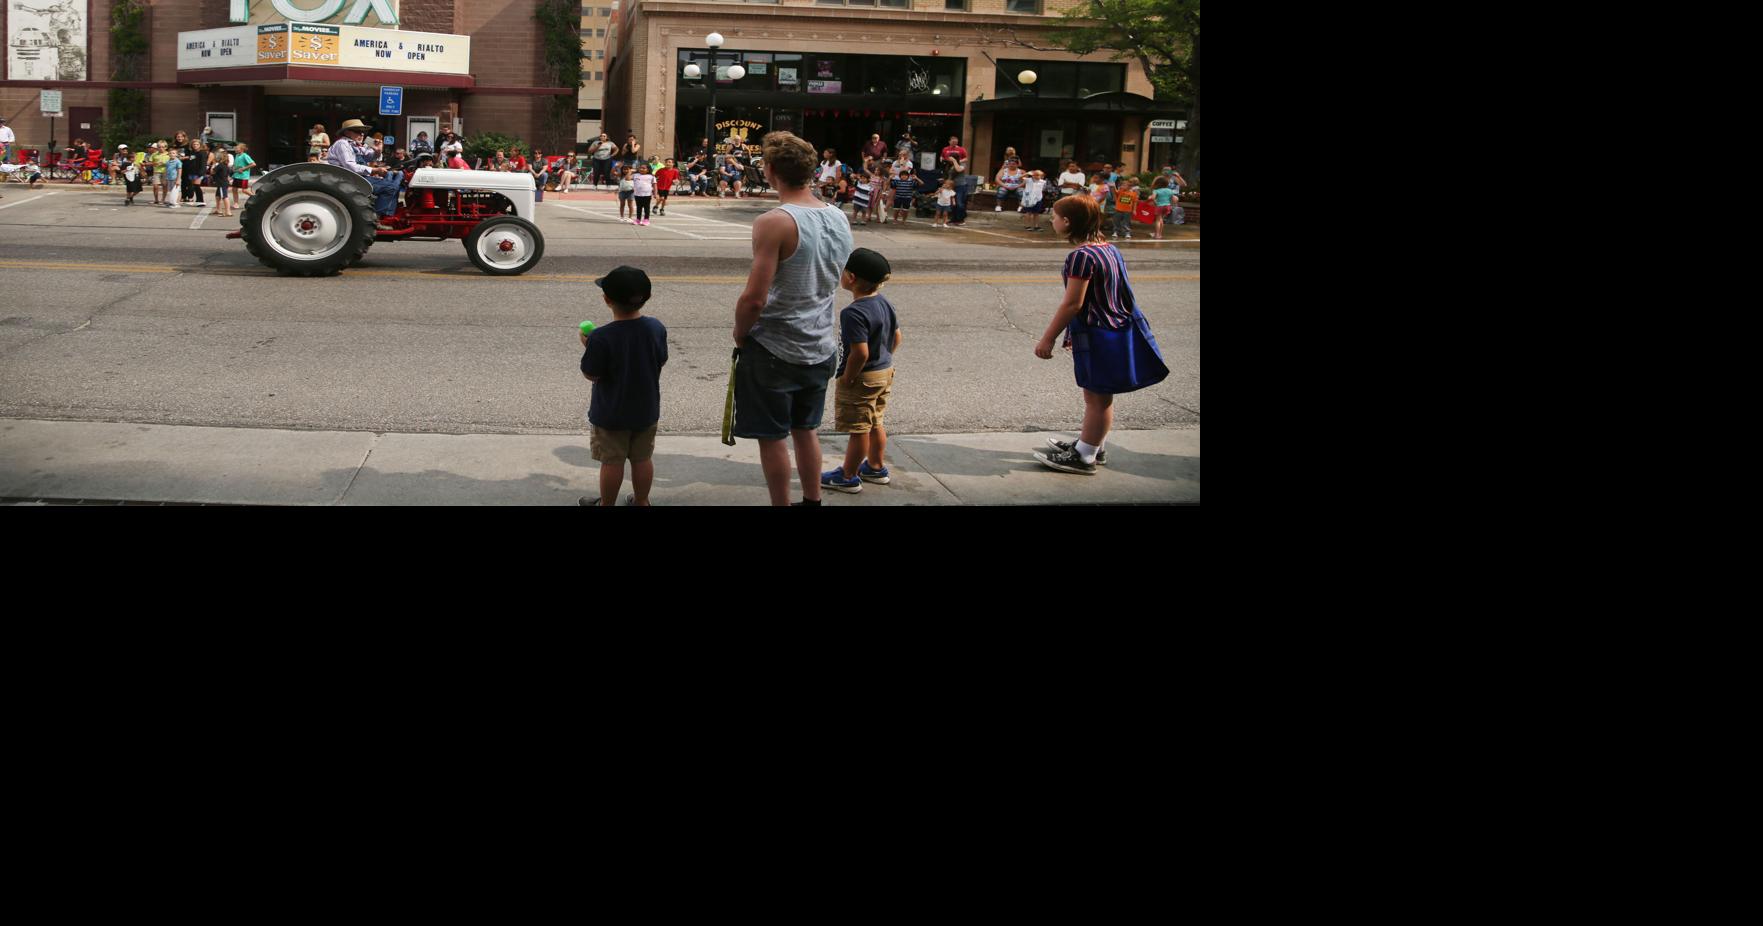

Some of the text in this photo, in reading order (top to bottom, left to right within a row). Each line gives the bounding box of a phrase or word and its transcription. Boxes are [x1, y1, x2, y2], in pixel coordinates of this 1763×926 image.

[354, 39, 388, 49] AMERICA
[417, 43, 444, 53] RIALTO
[375, 49, 426, 61] NOW OPEN
[715, 120, 762, 130] DISCOUNT
